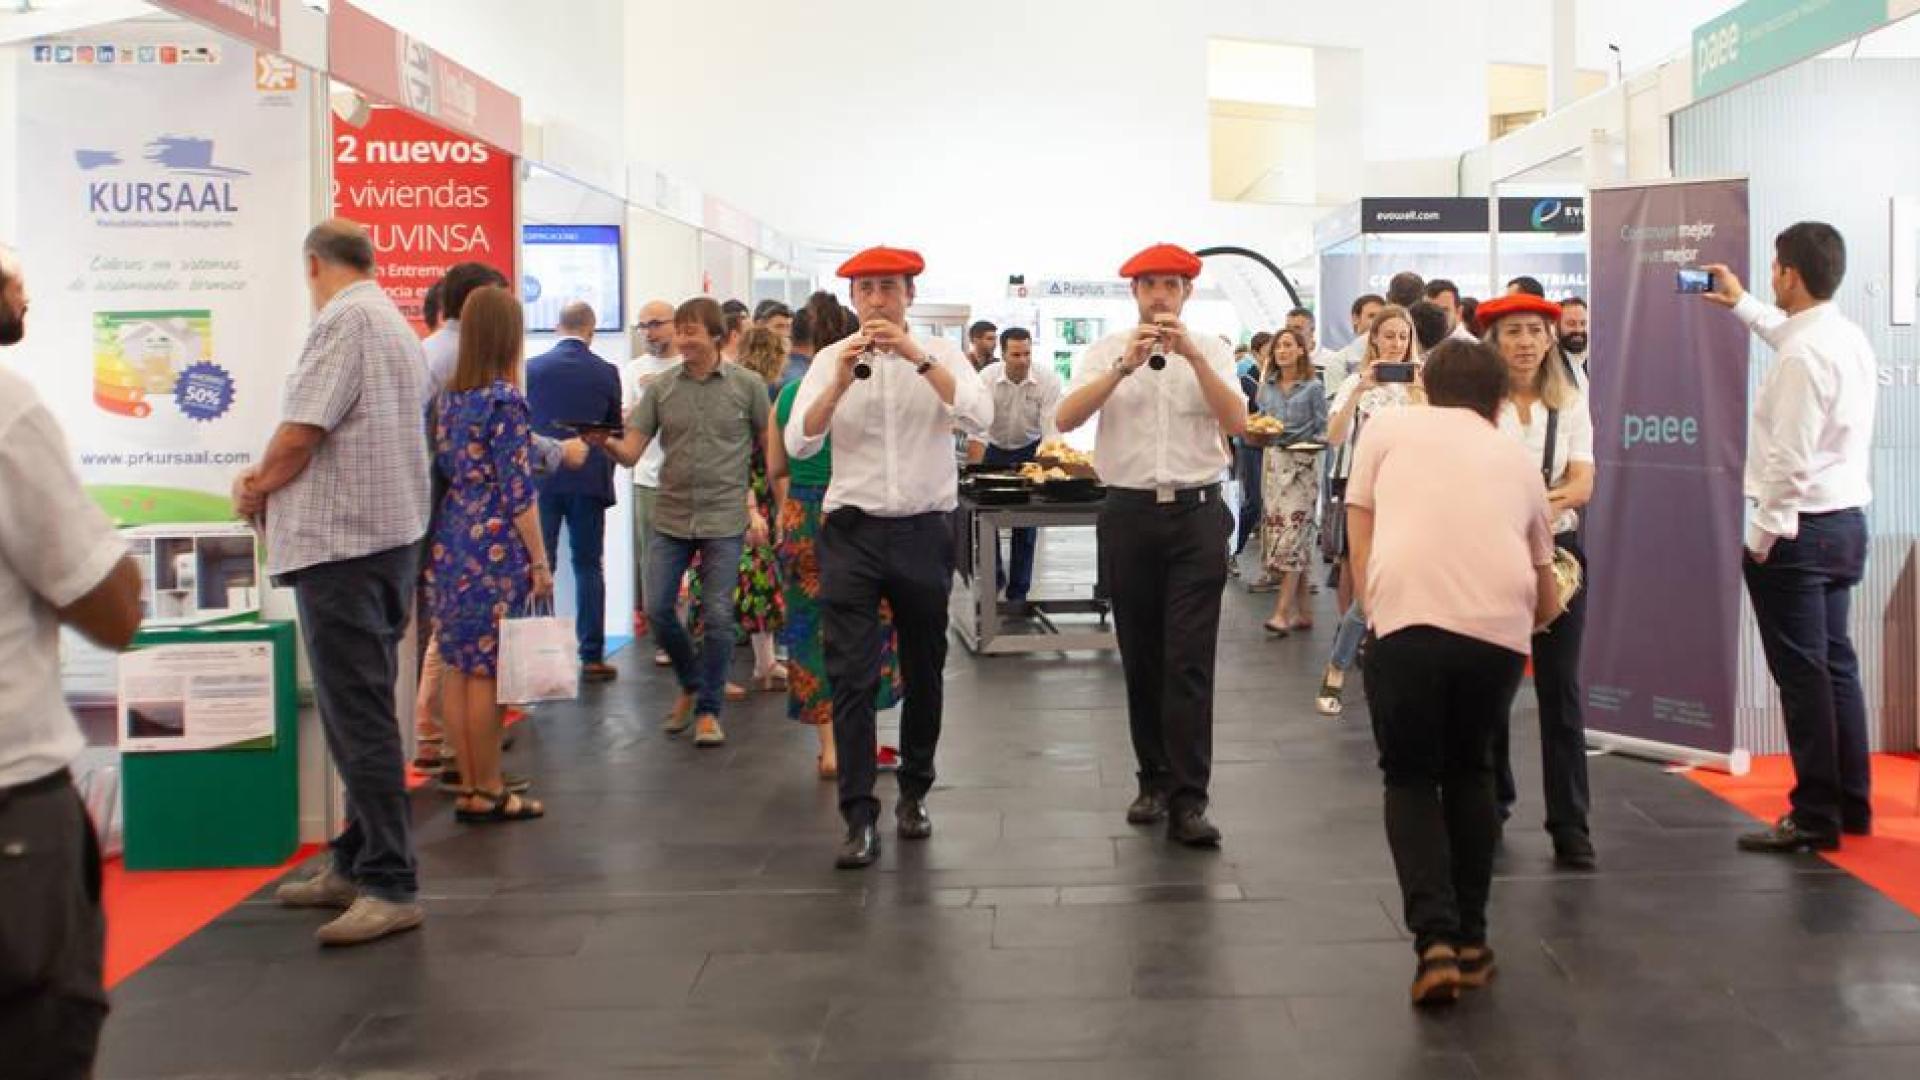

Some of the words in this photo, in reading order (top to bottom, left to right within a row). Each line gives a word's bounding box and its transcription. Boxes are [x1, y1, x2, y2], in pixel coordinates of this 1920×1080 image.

[337, 135, 359, 162] 2
[366, 139, 490, 163] nuevos
[89, 182, 239, 212] KURSAAL
[349, 178, 489, 208] viviendas
[1624, 413, 1698, 450] paee
[81, 450, 252, 467] www.prkursaal.com
